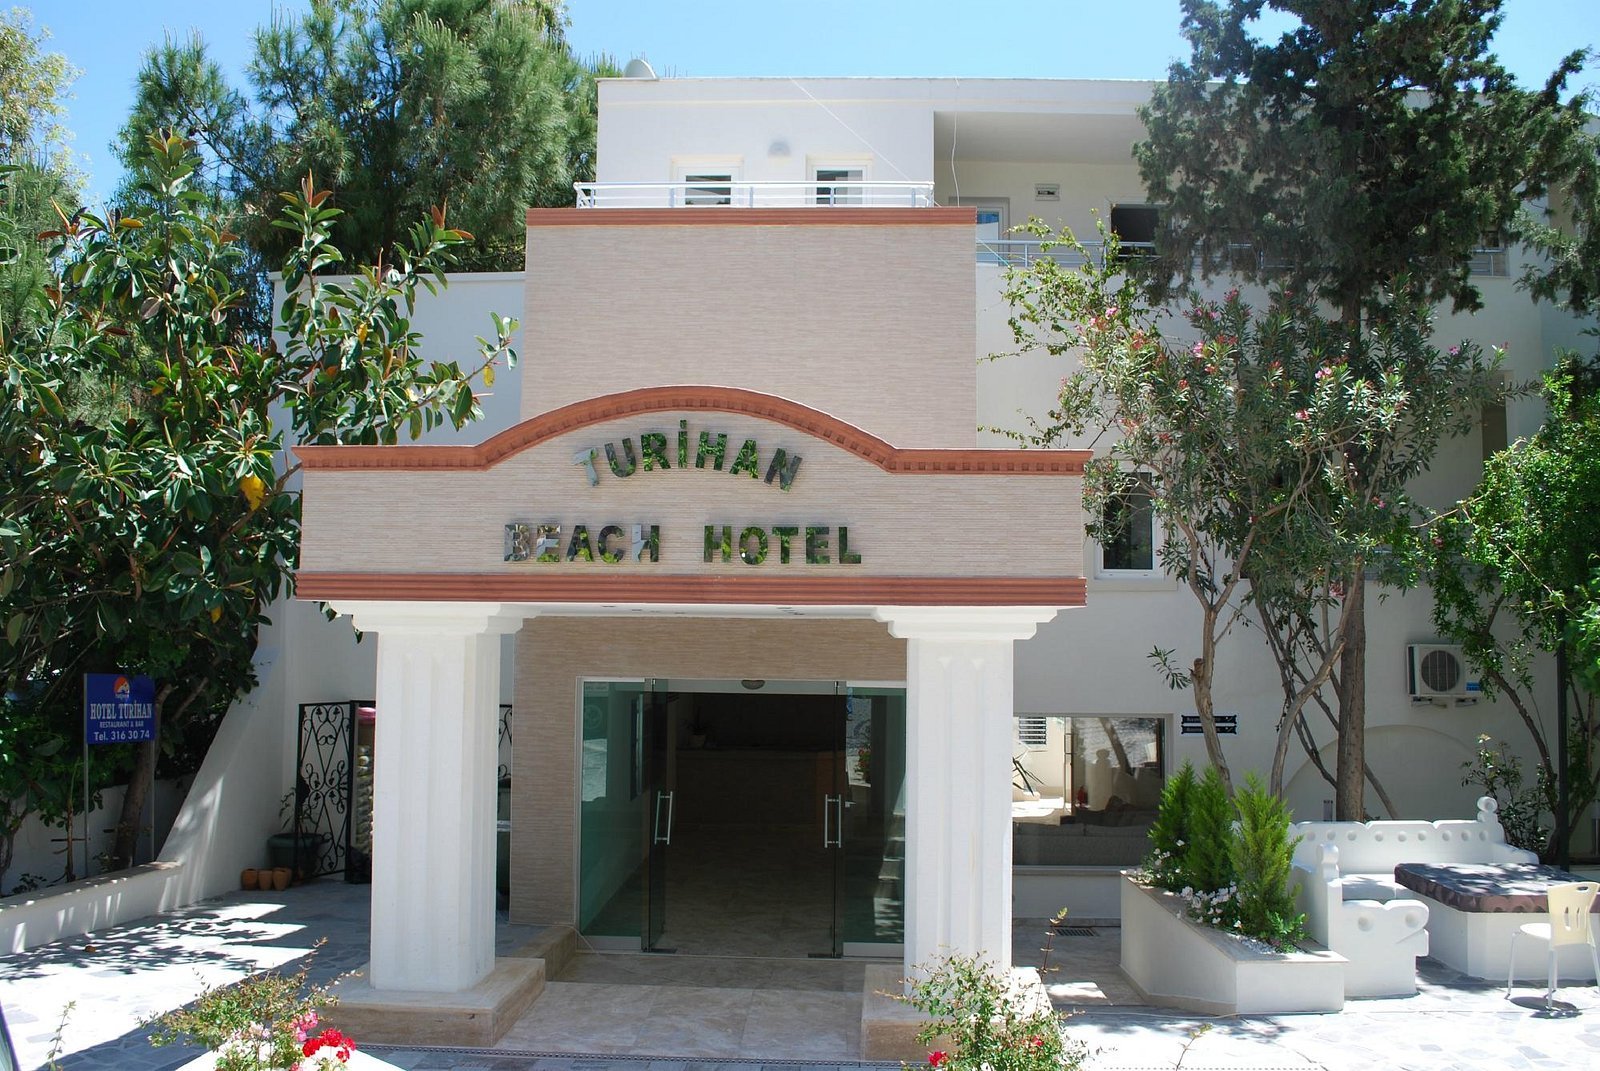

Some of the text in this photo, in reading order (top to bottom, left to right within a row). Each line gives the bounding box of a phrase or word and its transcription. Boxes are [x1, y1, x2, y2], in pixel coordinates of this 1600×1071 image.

[504, 524, 862, 565] BEACH HOTEL
[90, 703, 117, 720] HOTEL
[99, 721, 130, 729] RESTAURANT
[135, 720, 144, 728] BAR
[94, 730, 150, 741] Tel. 316 30 74
